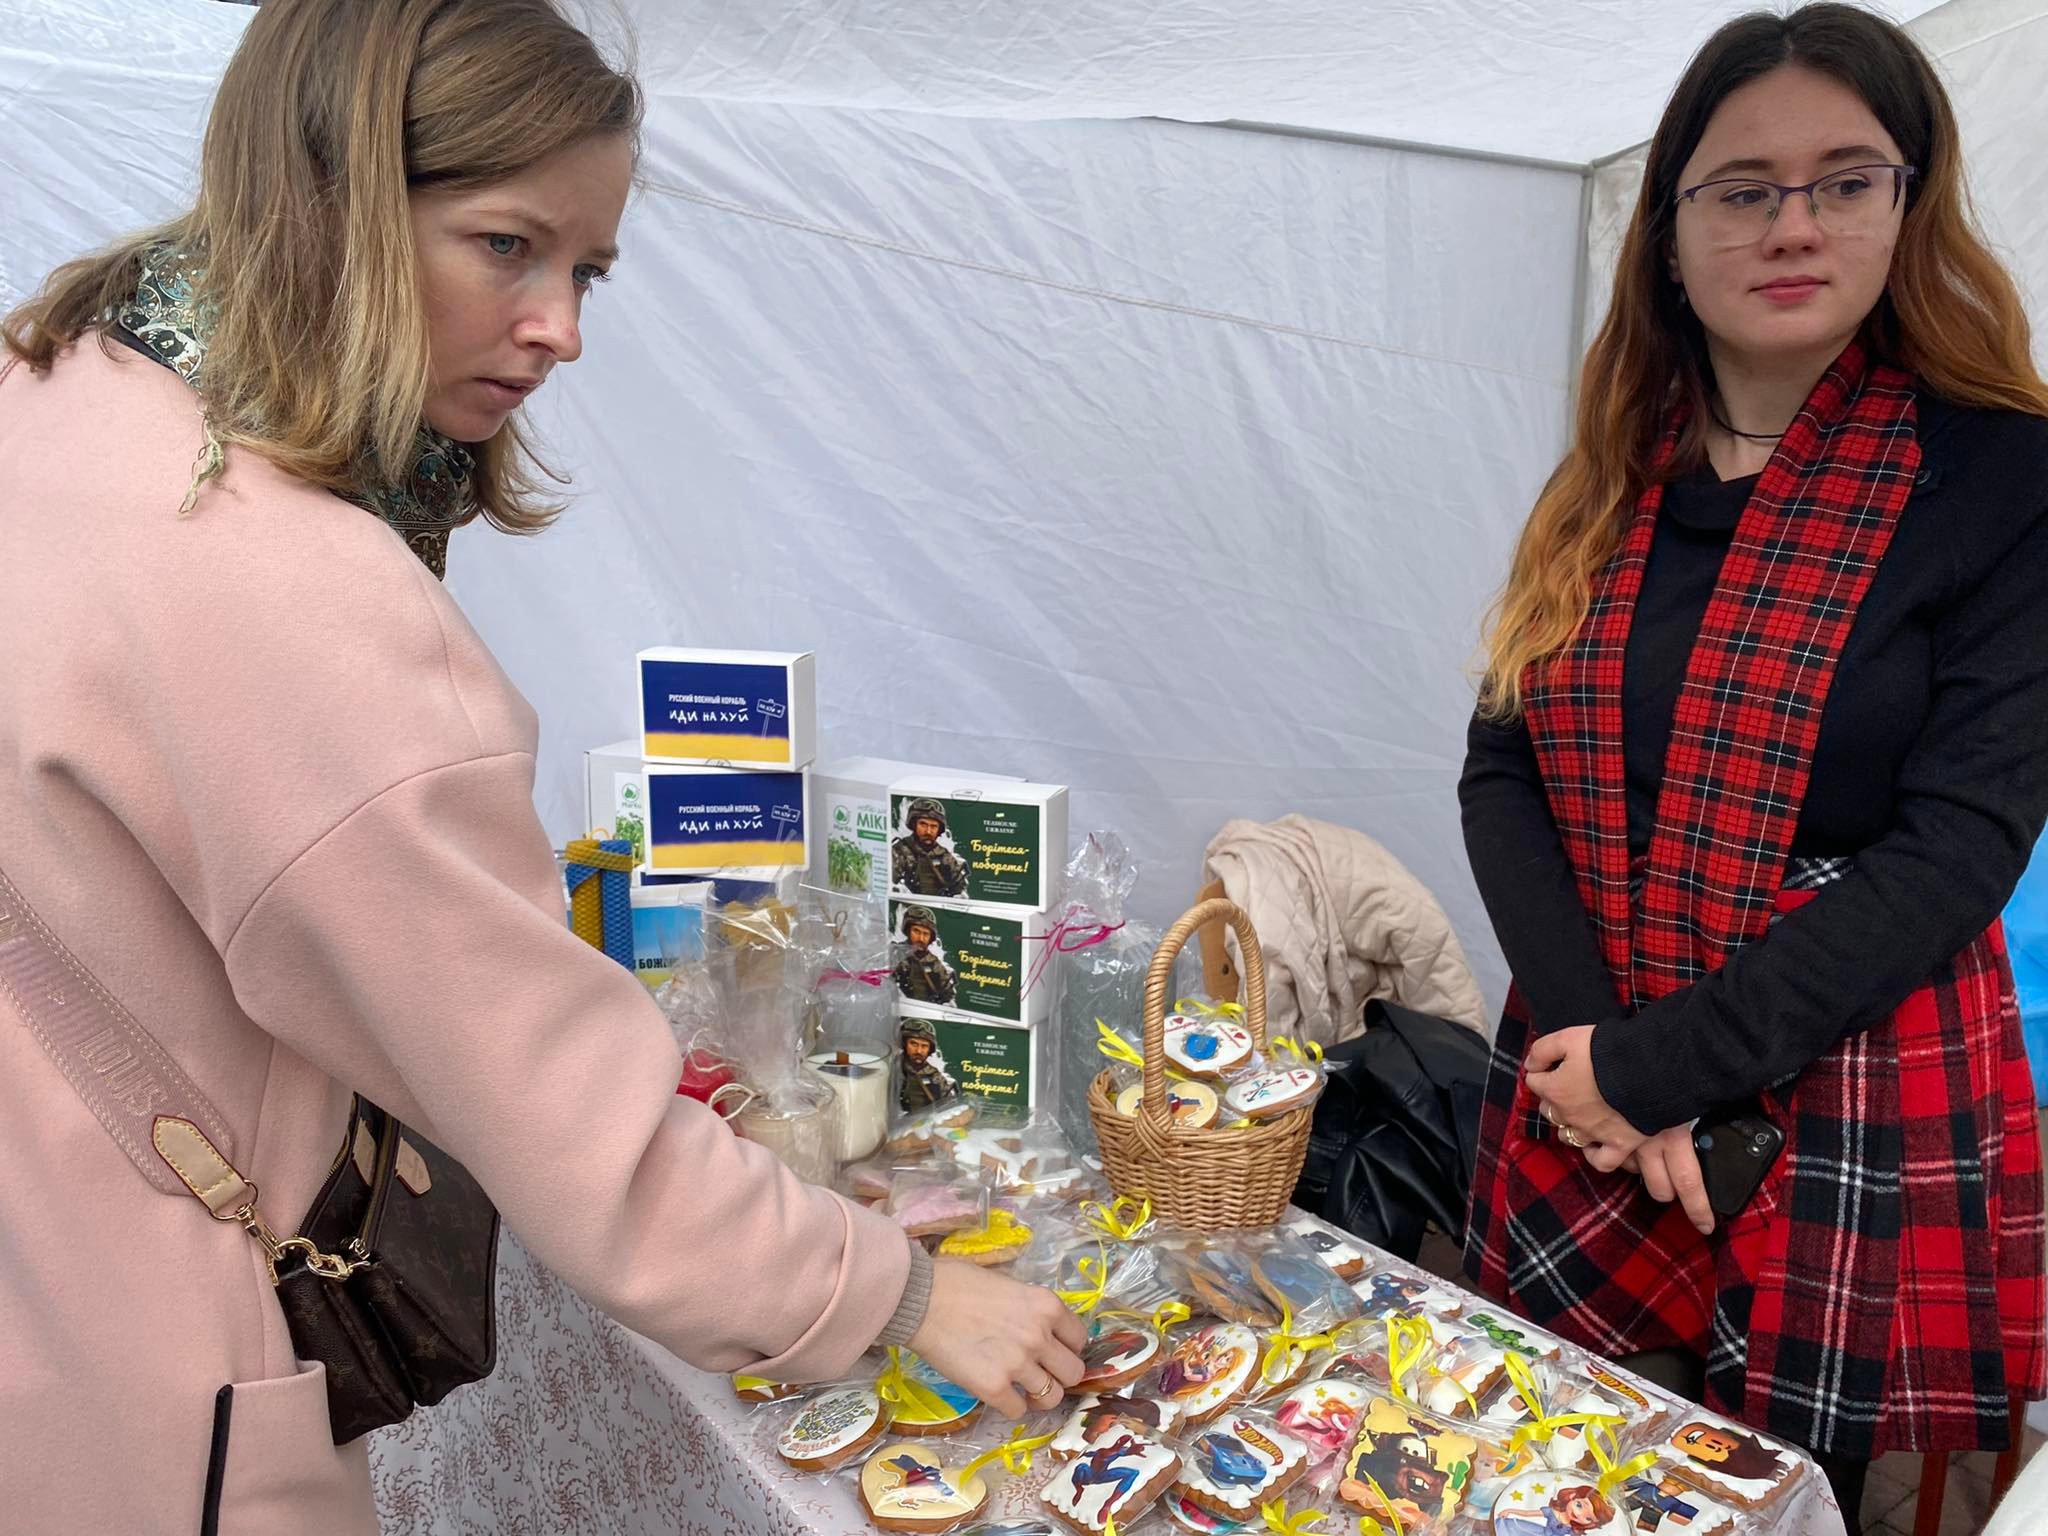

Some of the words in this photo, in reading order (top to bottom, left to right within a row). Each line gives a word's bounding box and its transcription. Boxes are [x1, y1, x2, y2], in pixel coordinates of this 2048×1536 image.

[669, 694, 693, 703] РУССКИЙ
[694, 694, 720, 704] ВОЕННЫЙ
[721, 695, 747, 705] КОРАБЛЬ
[669, 710, 698, 724] ИДИ
[703, 711, 717, 722] НА
[720, 708, 749, 722] ХУЙ
[679, 805, 705, 814] РУССКИЙ
[706, 804, 733, 813] ВОЕННЫЙ
[734, 804, 761, 813] КОРАБЛЬ
[679, 820, 709, 834] ИДИ
[715, 820, 730, 830] НА
[733, 815, 763, 830] ХУЙ
